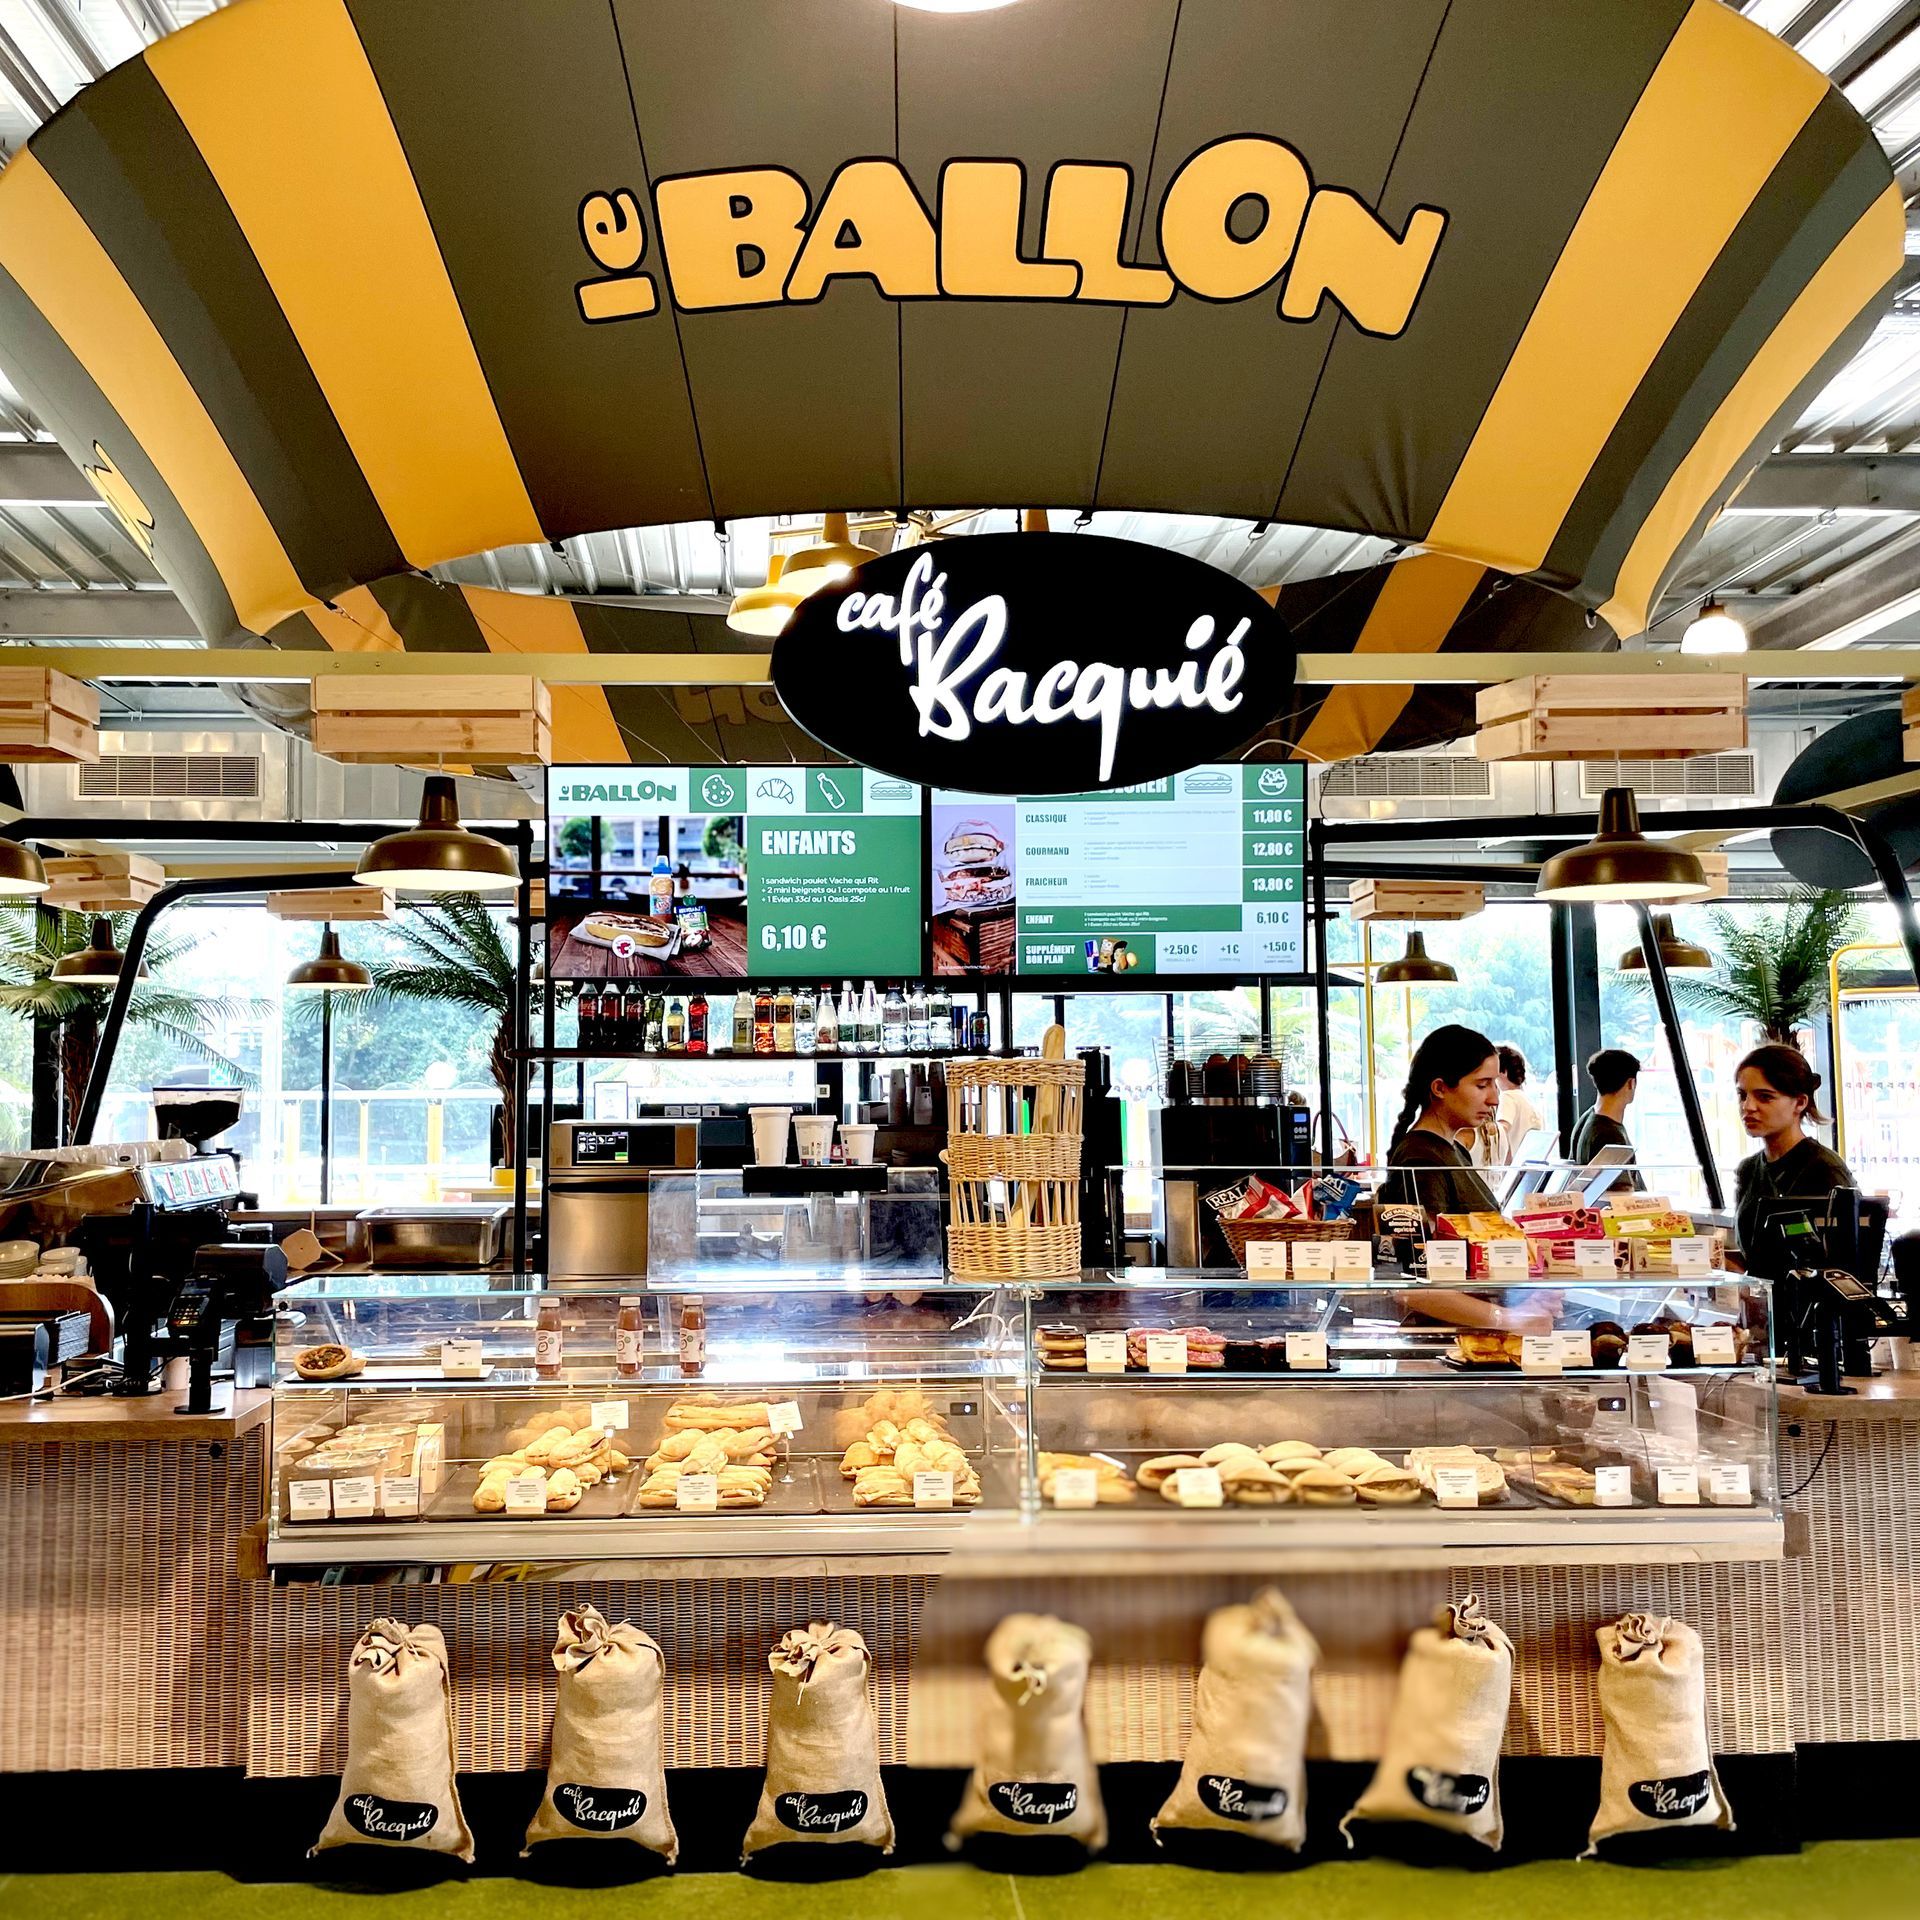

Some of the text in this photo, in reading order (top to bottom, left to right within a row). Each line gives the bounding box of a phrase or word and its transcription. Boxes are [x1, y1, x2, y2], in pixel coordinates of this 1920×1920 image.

[575, 132, 1450, 339] le BALLON
[836, 551, 1252, 782] café Bacquié
[558, 780, 677, 801] le BALLON
[1025, 814, 1067, 823] CLASSIQUE
[1253, 809, 1293, 823] 11,80 €
[762, 830, 856, 855] ENFANTS
[1252, 842, 1293, 856] 12,80 €
[1025, 847, 1069, 856] GOURMAND
[766, 877, 802, 885] sandwich
[803, 877, 827, 886] poulet
[829, 877, 853, 885] Vache
[854, 877, 866, 886] qui
[1025, 877, 1068, 887] FRAICHEUR
[1252, 877, 1293, 892] 13,80 €
[791, 886, 825, 895] beignets
[842, 886, 877, 895] compote
[1025, 914, 1054, 924] ENFANT
[1256, 911, 1289, 924] 6,10 €
[762, 925, 827, 951] 6,10 €
[1025, 943, 1076, 955] SUPPLÉMENT
[1191, 944, 1198, 954] €
[1232, 944, 1239, 954] €
[1289, 941, 1296, 952] €
[1025, 955, 1064, 964] BON PLAN
[1210, 1186, 1247, 1207] REAL
[998, 1783, 1022, 1802] café
[1208, 1778, 1233, 1797] café
[563, 1786, 583, 1805] café
[353, 1795, 375, 1816] café
[785, 1793, 807, 1814] café
